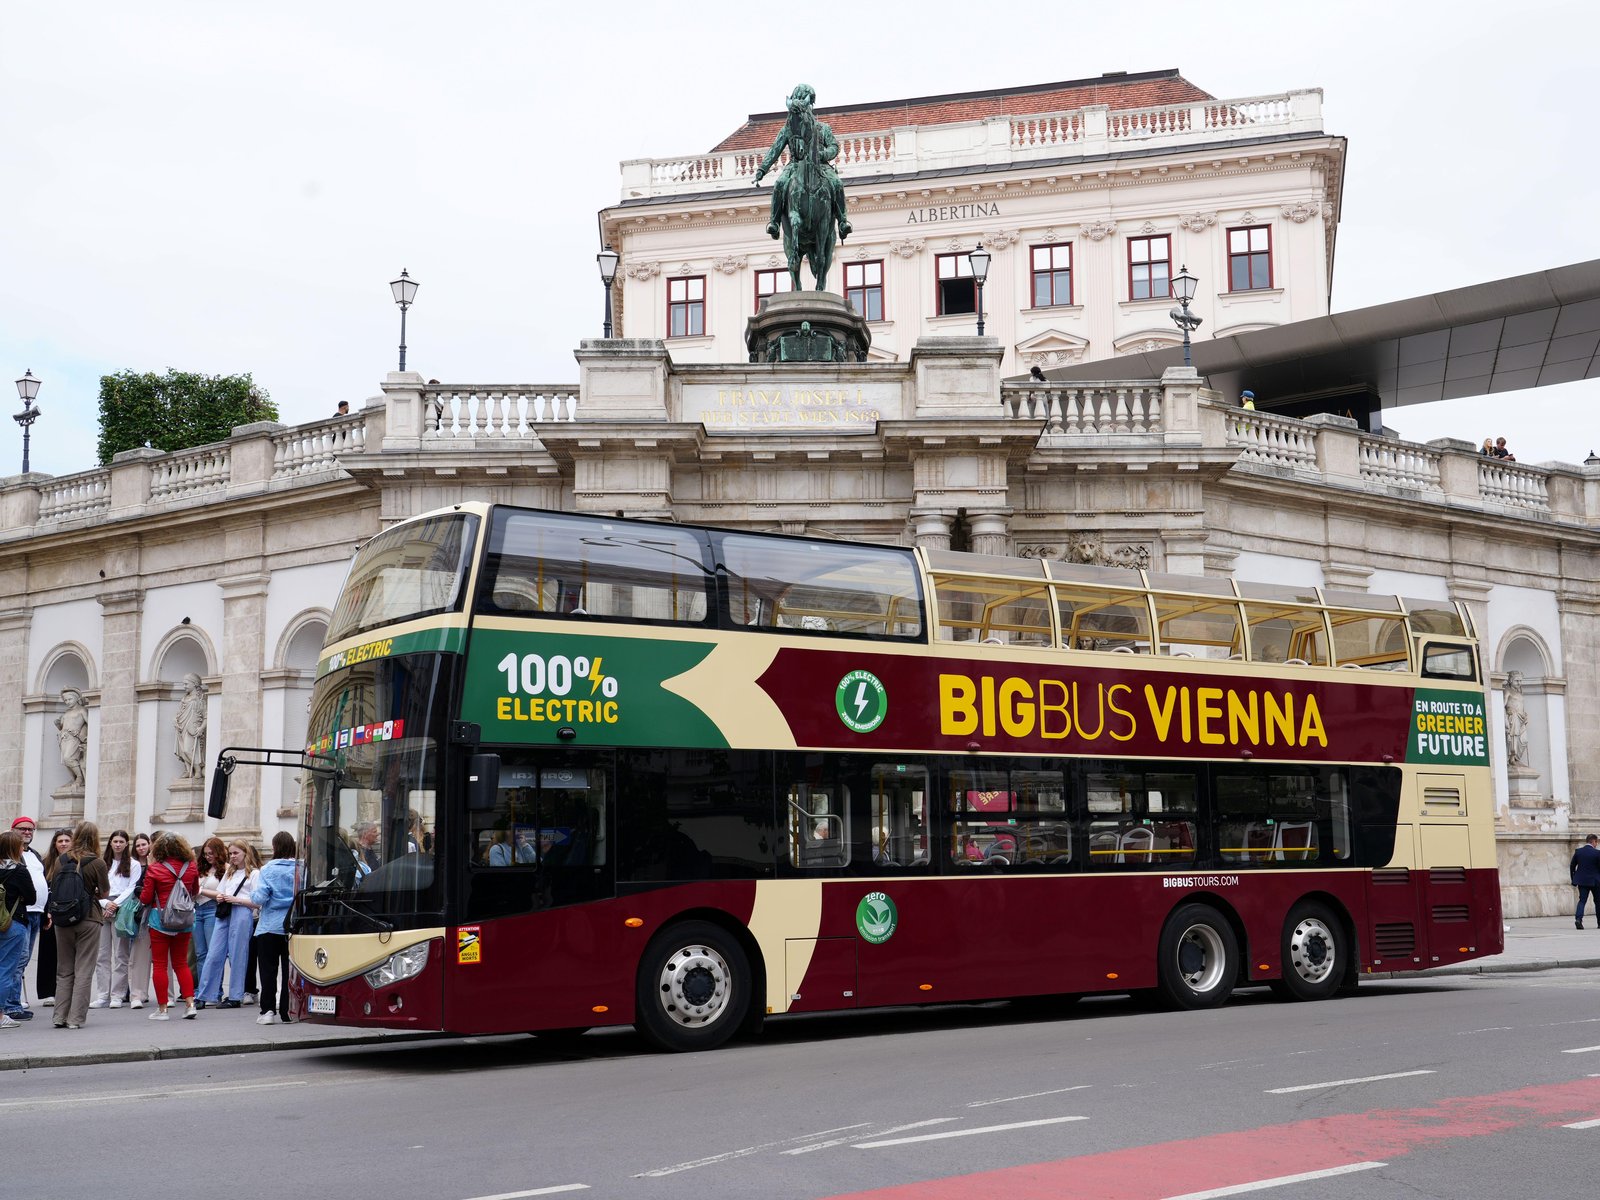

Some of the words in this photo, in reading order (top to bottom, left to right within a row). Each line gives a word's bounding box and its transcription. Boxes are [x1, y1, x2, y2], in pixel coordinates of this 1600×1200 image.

[907, 202, 1000, 224] ALBERTINA
[717, 389, 783, 406] FRANZ
[791, 389, 848, 406] JOSEF
[798, 410, 840, 423] WIEN
[843, 409, 881, 423] 1869
[346, 638, 393, 667] ELECTRIC
[497, 652, 618, 698] 100%
[839, 674, 855, 690] 100%
[854, 671, 884, 693] ELECTRIC
[497, 697, 618, 723] ELECTRIC
[938, 673, 1137, 742] BIGBUS
[1144, 683, 1328, 748] VIENNA
[1415, 700, 1428, 713] EN
[1430, 701, 1460, 715] ROUTE
[1462, 703, 1473, 715] TO
[1475, 704, 1482, 716] A
[841, 711, 855, 727] ZERO
[1416, 713, 1483, 734] GREENER
[1417, 733, 1485, 757] FUTURE
[1163, 875, 1239, 888] BIGBUSTOURS.COM
[865, 892, 886, 903] zero
